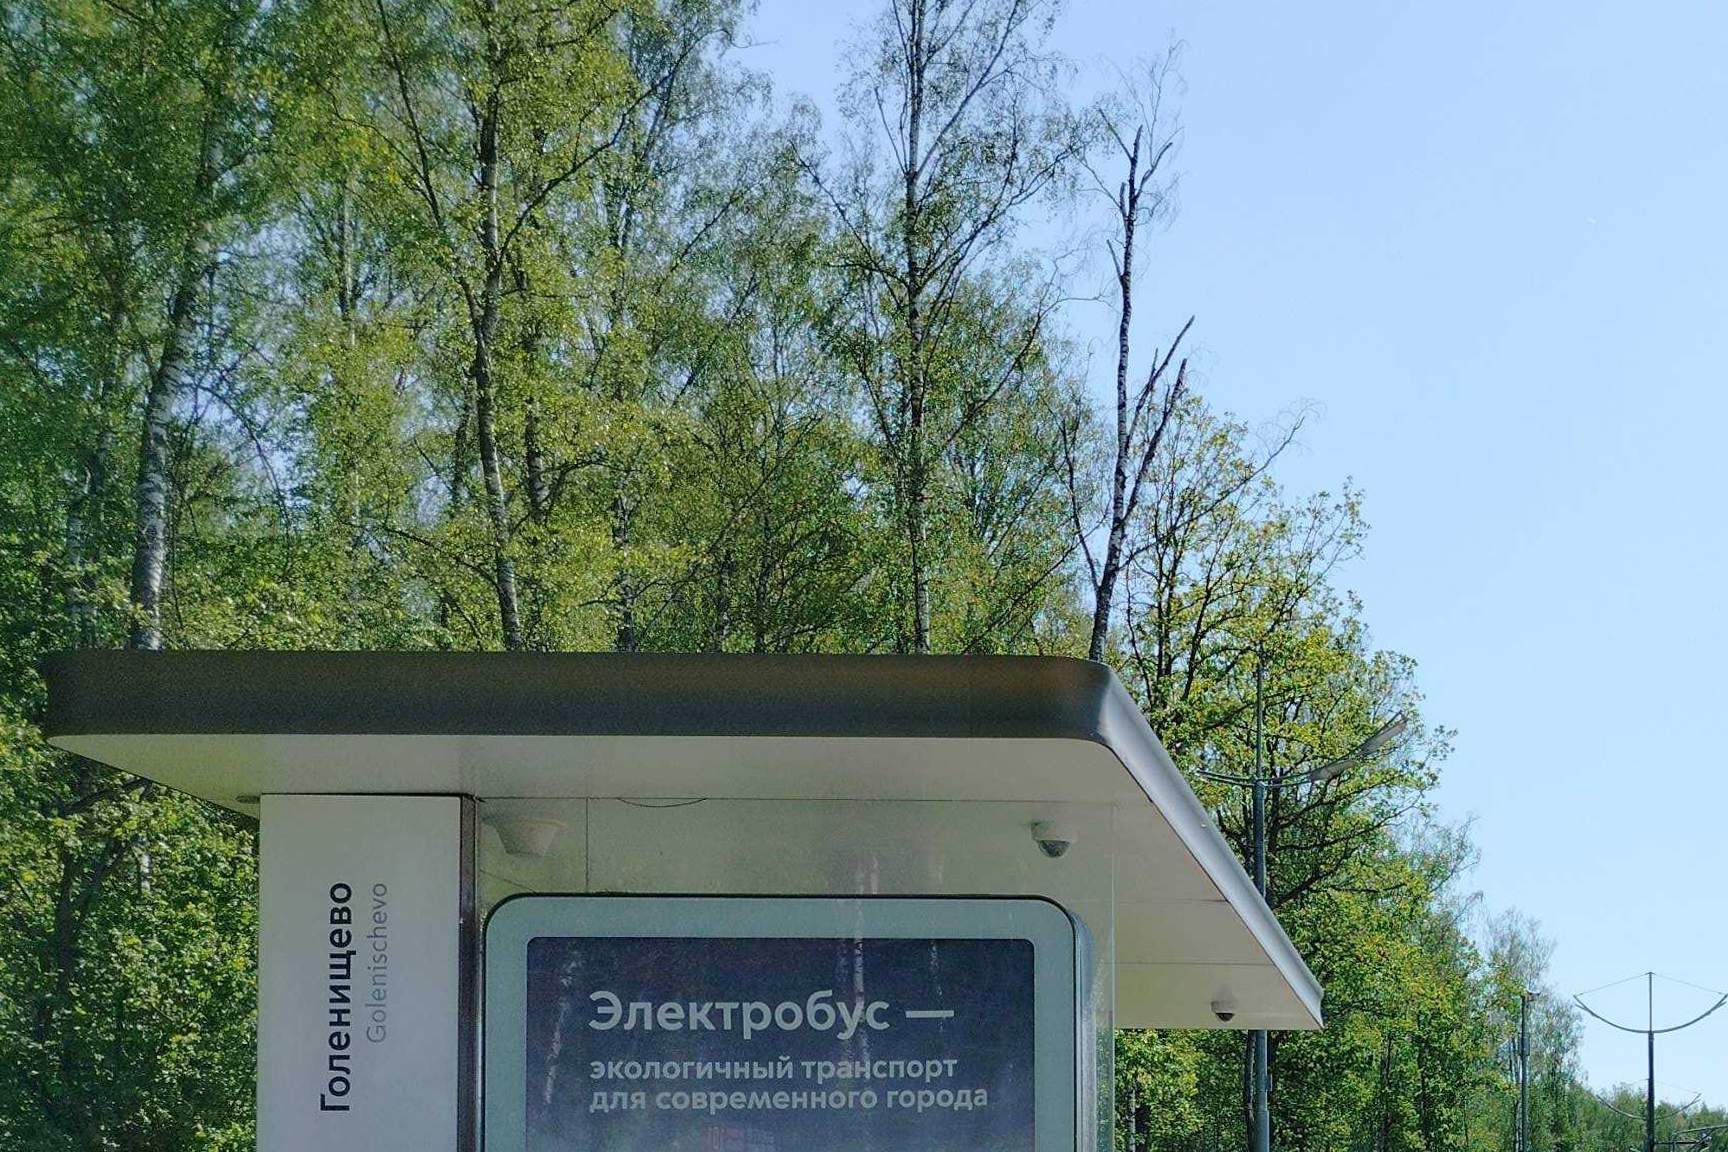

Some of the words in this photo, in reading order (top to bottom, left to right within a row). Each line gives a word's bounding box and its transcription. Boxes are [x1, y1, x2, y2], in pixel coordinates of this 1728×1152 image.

[365, 883, 387, 1043] Golenischevo
[320, 883, 357, 1111] Голенищево
[588, 989, 891, 1040] Электробус
[589, 1055, 794, 1080] экологичный
[801, 1057, 958, 1084] транспорт
[589, 1090, 650, 1114] для
[655, 1088, 878, 1115] современного
[886, 1086, 988, 1112] города
